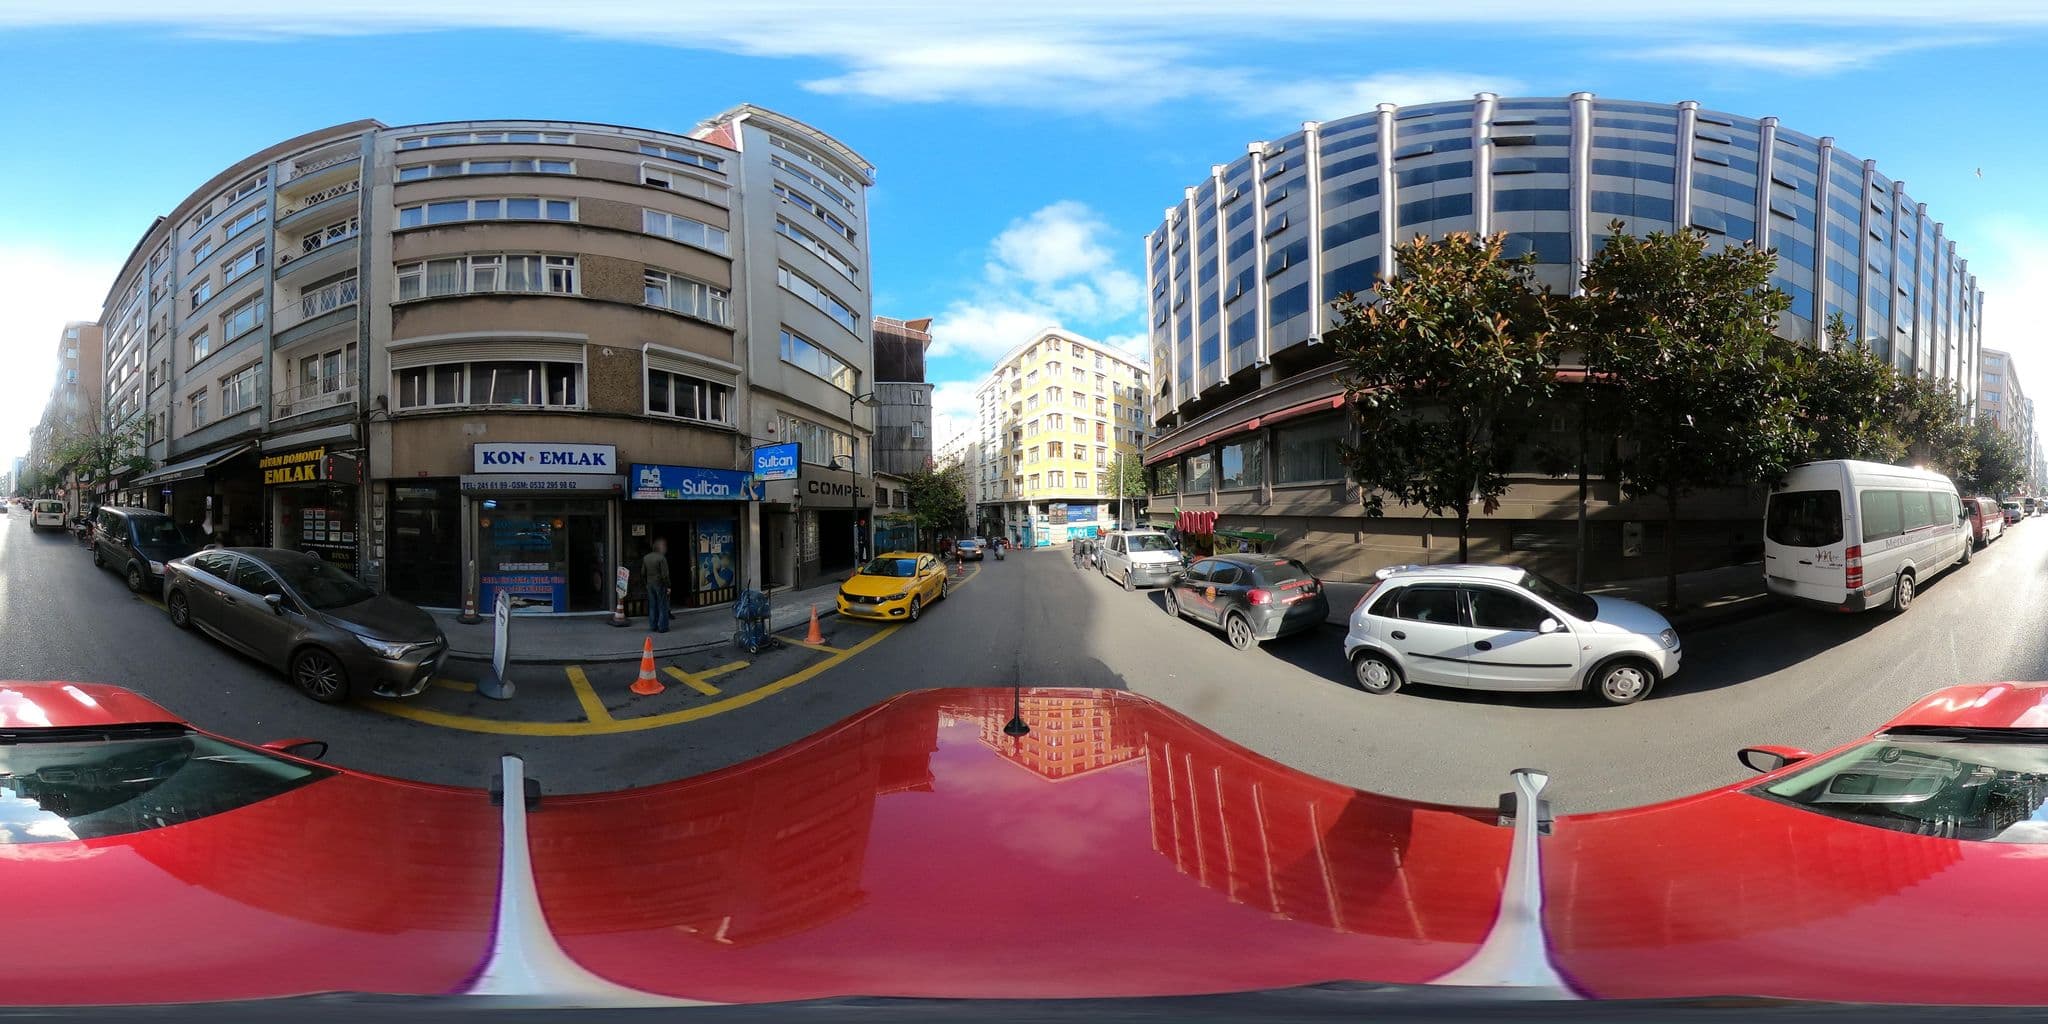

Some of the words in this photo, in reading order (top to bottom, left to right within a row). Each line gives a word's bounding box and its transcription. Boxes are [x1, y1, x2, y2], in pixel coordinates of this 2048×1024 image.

[482, 451, 526, 465] KON
[539, 451, 607, 466] EMLAK
[758, 455, 793, 469] Sultan
[264, 464, 317, 485] EMLAK
[462, 482, 476, 490] TEL:
[529, 481, 546, 489] 0532
[546, 481, 558, 489] 295
[682, 479, 729, 496] Sultan
[807, 480, 866, 498] COMPEL
[699, 532, 734, 545] Sultan
